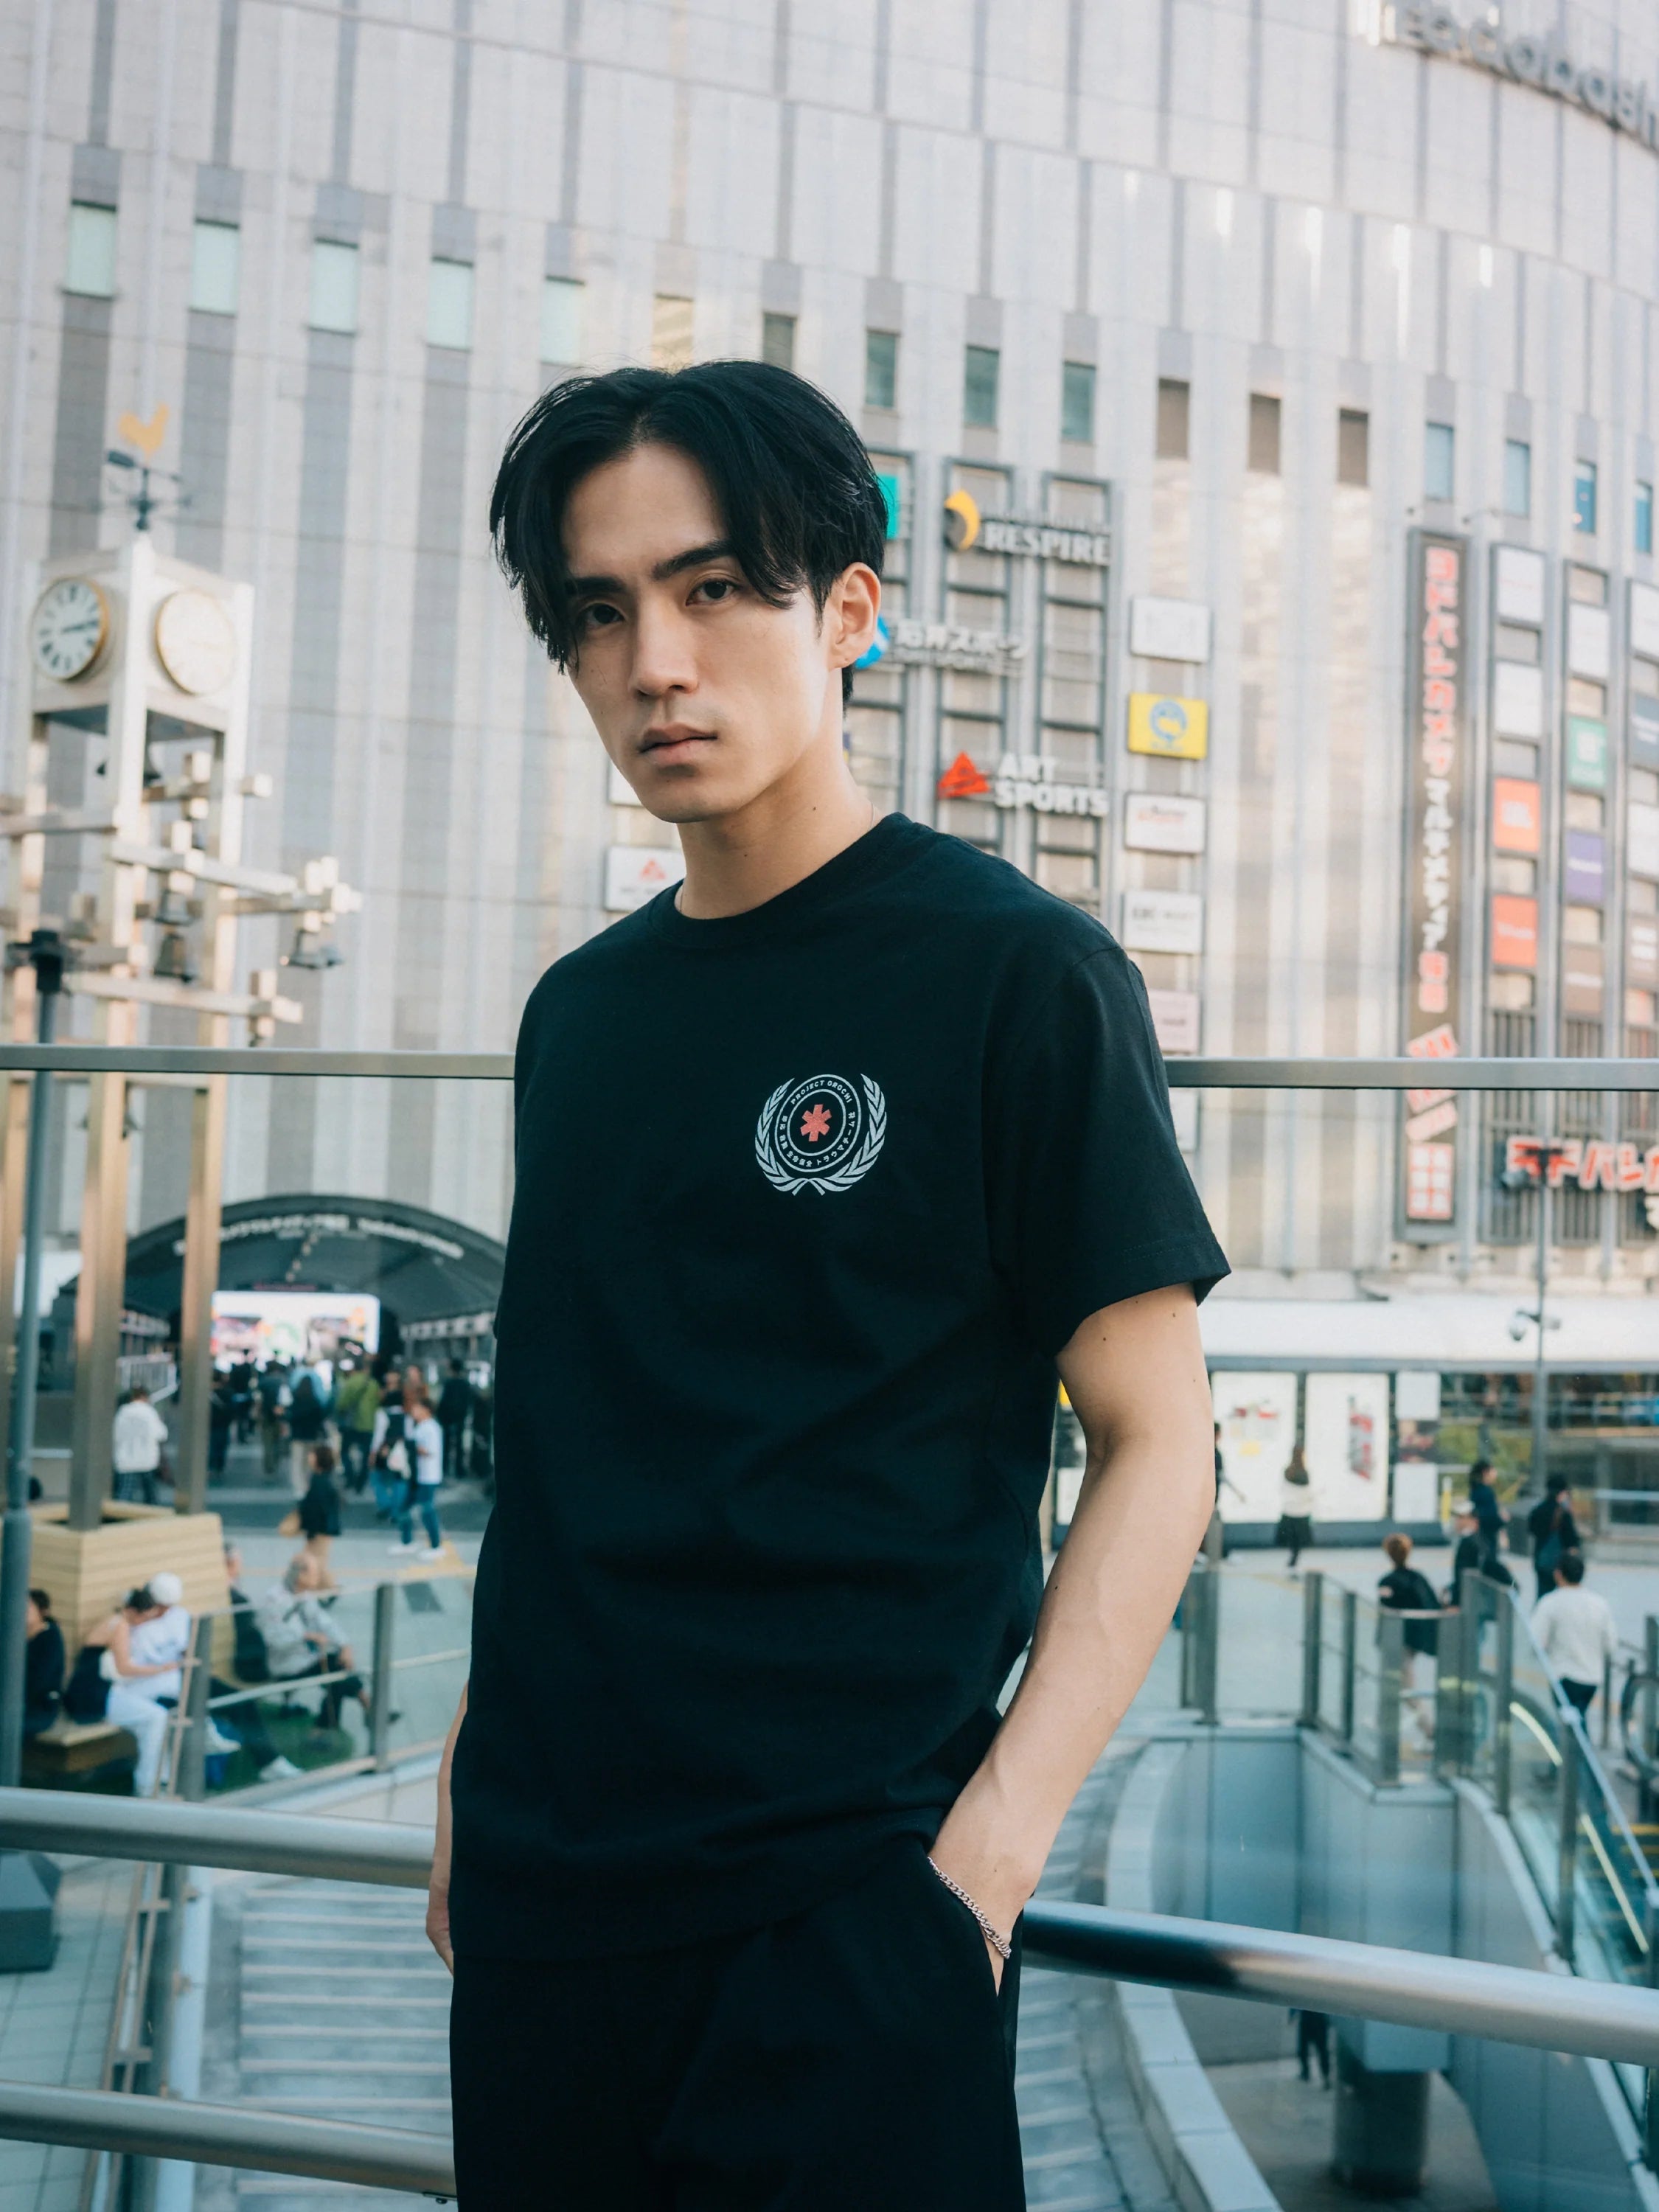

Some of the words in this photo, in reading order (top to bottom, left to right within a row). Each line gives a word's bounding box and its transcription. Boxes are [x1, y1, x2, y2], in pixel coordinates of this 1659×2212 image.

[984, 522, 1110, 566] RESPIRE
[998, 751, 1057, 782] ART
[994, 779, 1110, 818] SPORTS
[790, 1079, 825, 1105] PROJECT
[827, 1079, 852, 1104] OROCHI
